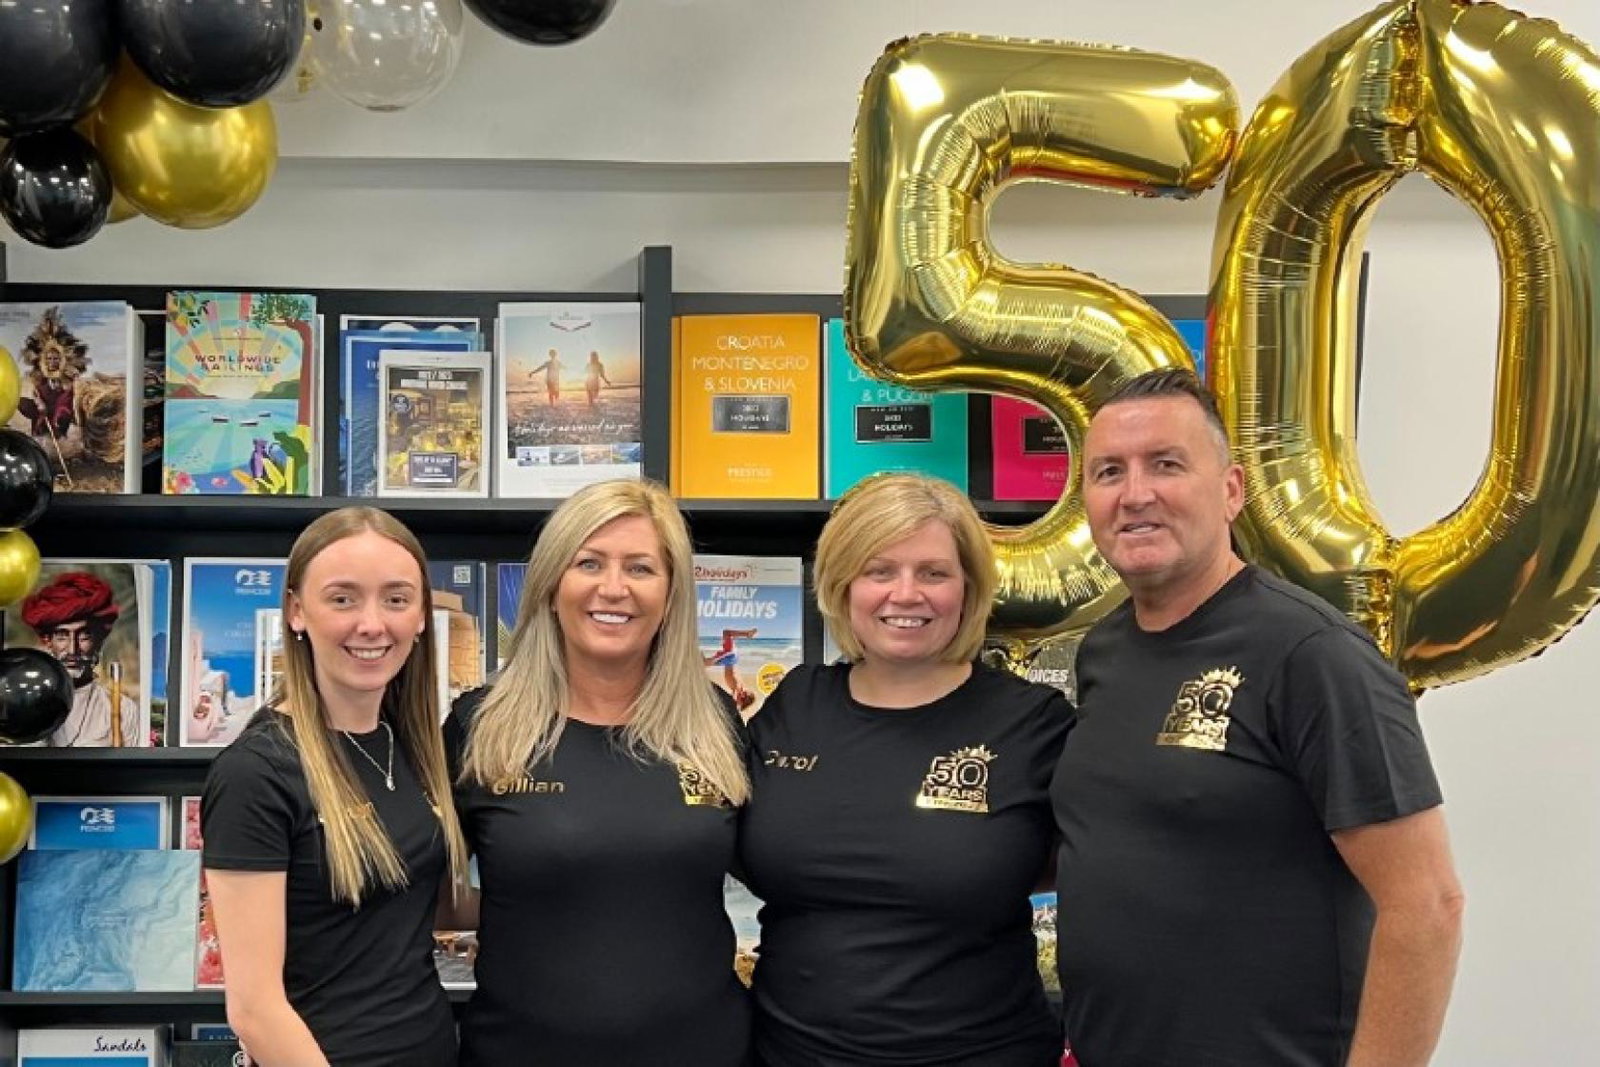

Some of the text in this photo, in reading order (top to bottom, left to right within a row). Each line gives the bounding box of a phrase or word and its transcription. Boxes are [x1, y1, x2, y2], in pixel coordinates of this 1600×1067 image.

[716, 335, 785, 351] CROATIA
[195, 354, 282, 365] WORLDWIDE
[692, 355, 810, 371] MONTENEGRO
[703, 375, 798, 393] & SLOVENIA
[711, 585, 759, 600] FAMILY
[1173, 680, 1234, 718] 50
[927, 756, 989, 788] 50
[493, 777, 565, 796] Gillian
[923, 782, 986, 803] YEARS
[93, 1034, 148, 1053] Sandals
